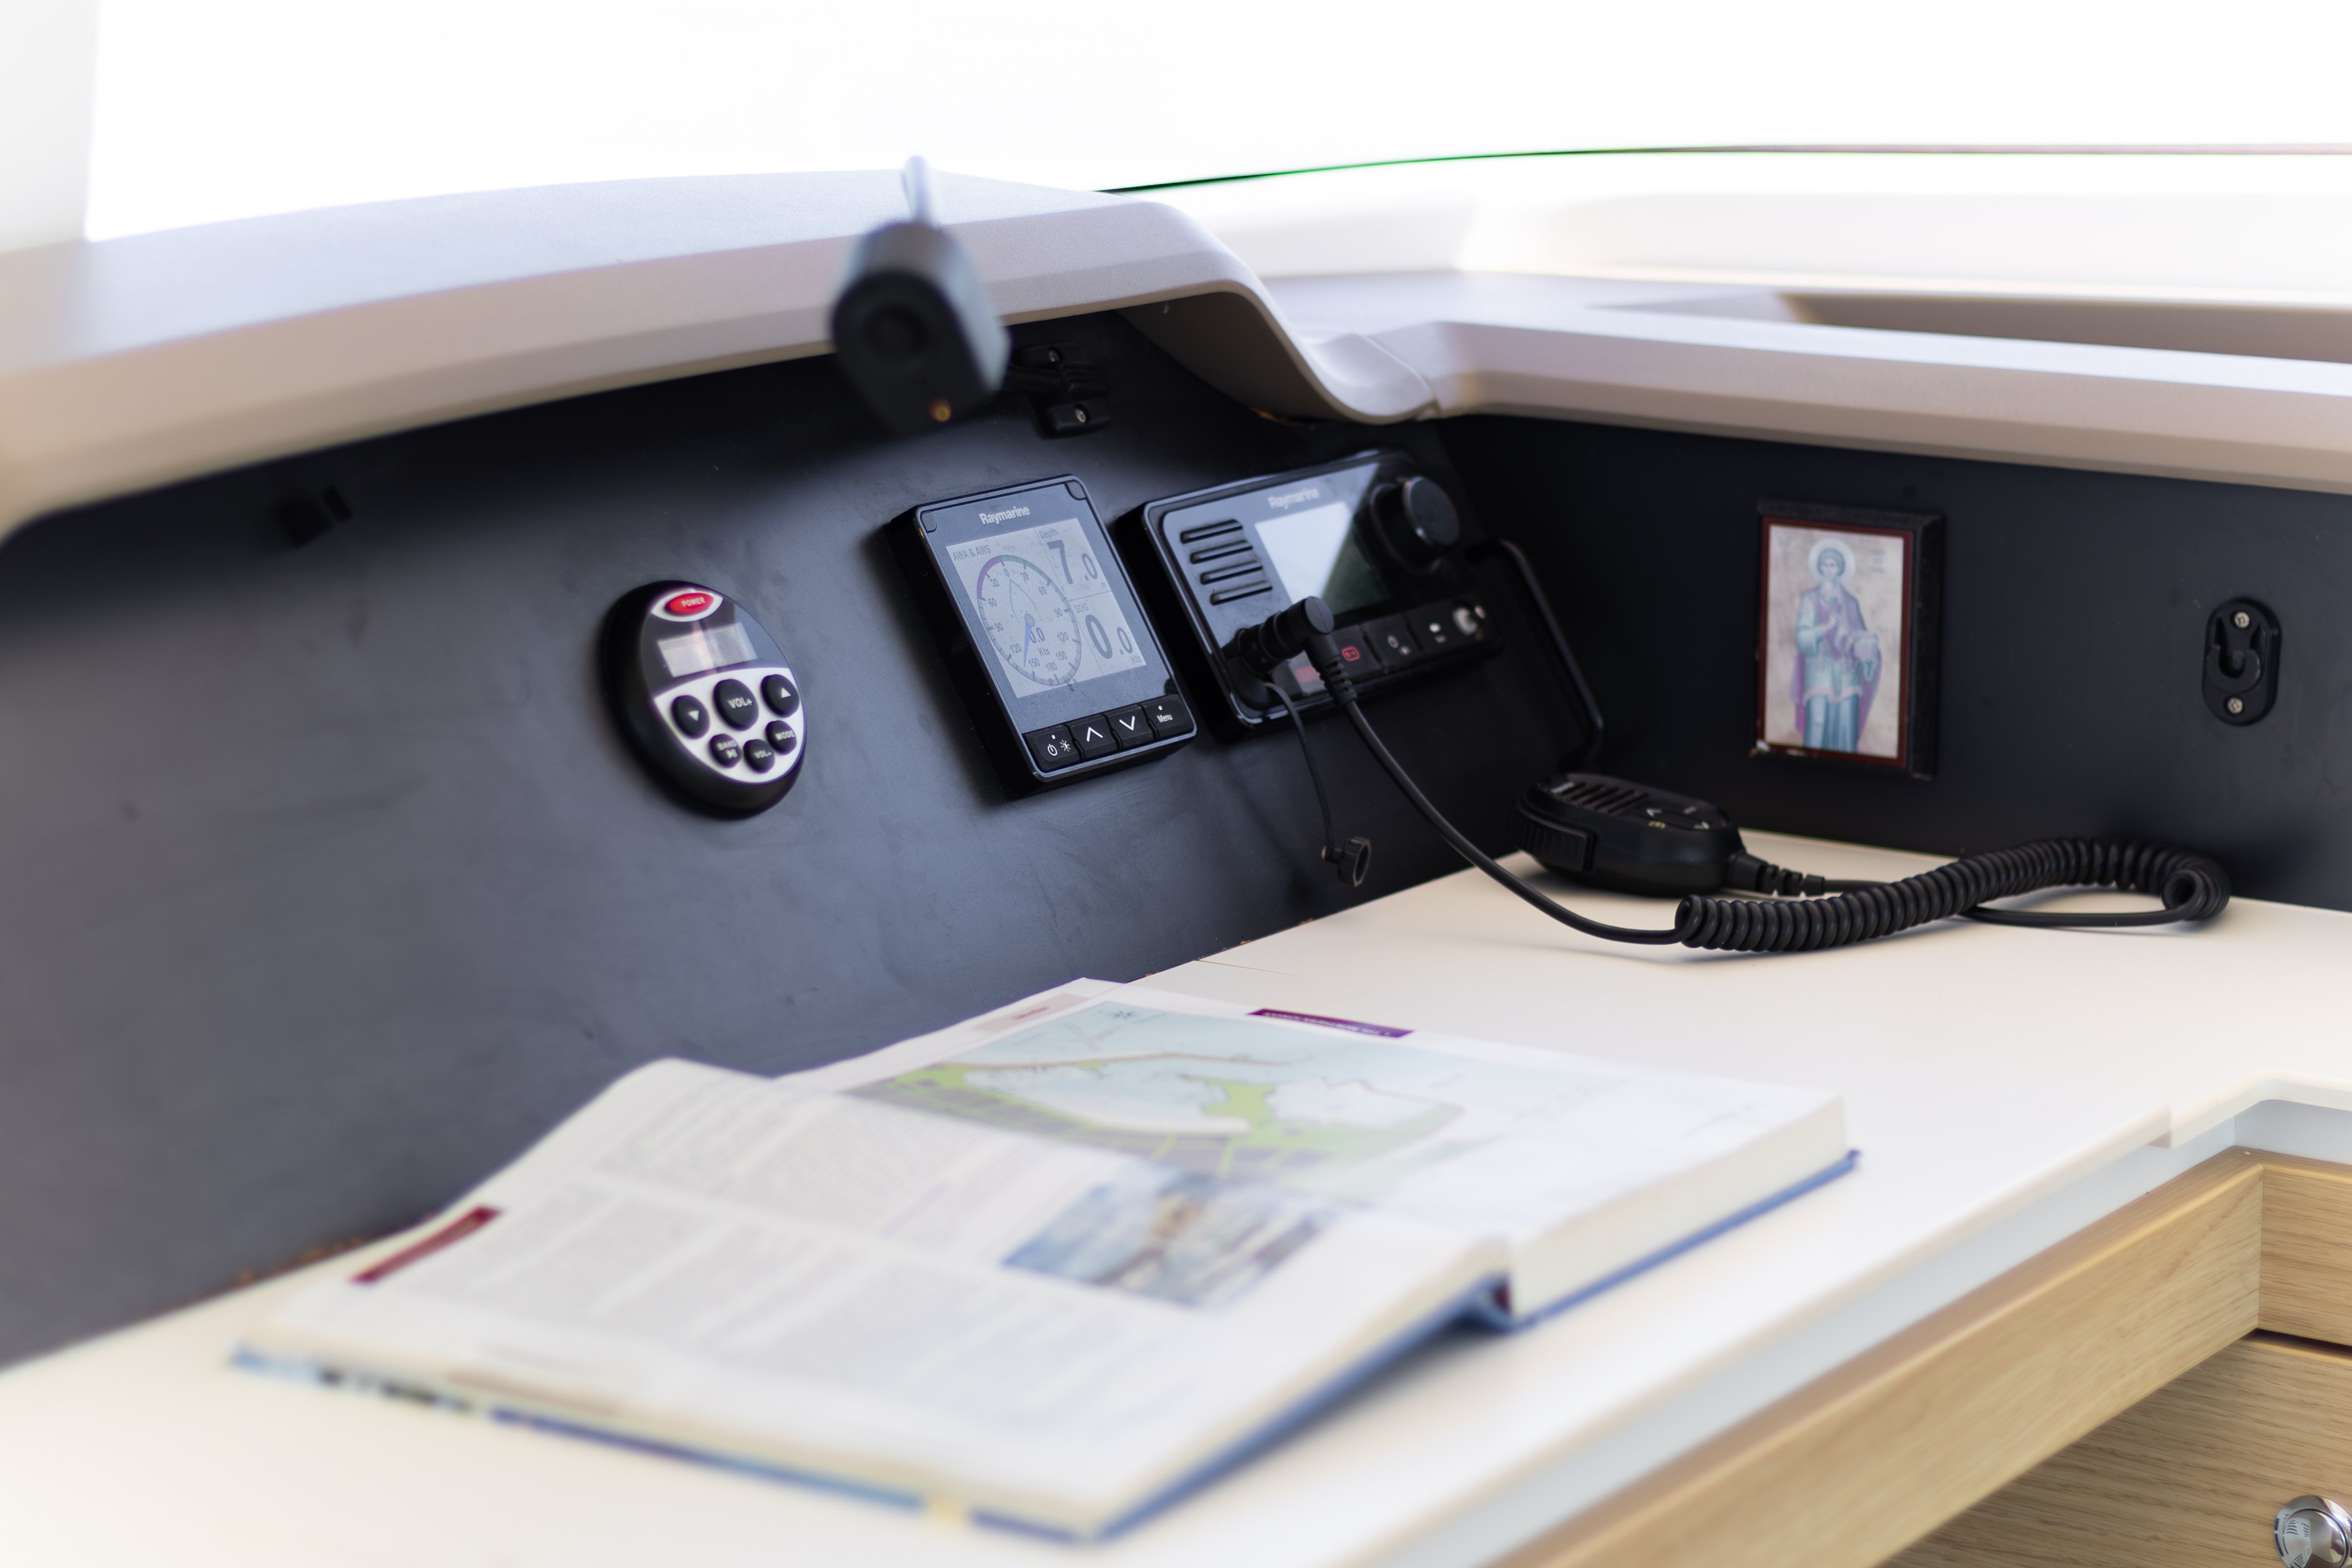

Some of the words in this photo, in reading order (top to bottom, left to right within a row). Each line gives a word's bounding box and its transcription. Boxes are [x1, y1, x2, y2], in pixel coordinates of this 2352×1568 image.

[1268, 488, 1320, 509] Raymarine
[979, 506, 1030, 525] Raymarine
[1038, 528, 1058, 540] Depth
[952, 550, 969, 562] AWA
[969, 548, 976, 557] &
[976, 545, 991, 555] AWS
[1004, 569, 1010, 577] 0
[991, 578, 999, 588] 30
[1038, 586, 1047, 596] 60
[681, 597, 706, 608] POWER
[988, 598, 997, 607] 60
[1054, 608, 1063, 618] 90
[1074, 603, 1089, 614] SOG
[994, 623, 1003, 632] 90
[1057, 632, 1069, 642] 120
[1086, 614, 1133, 660] 0.0
[1010, 643, 1022, 654] 120
[1038, 647, 1050, 657] Kts
[1055, 651, 1067, 662] 150
[1028, 658, 1040, 668] 150
[1045, 662, 1058, 672] 180
[727, 697, 753, 709] VOL+
[1157, 714, 1173, 723] Menu
[775, 729, 795, 741] MODE
[716, 739, 738, 751] BAND
